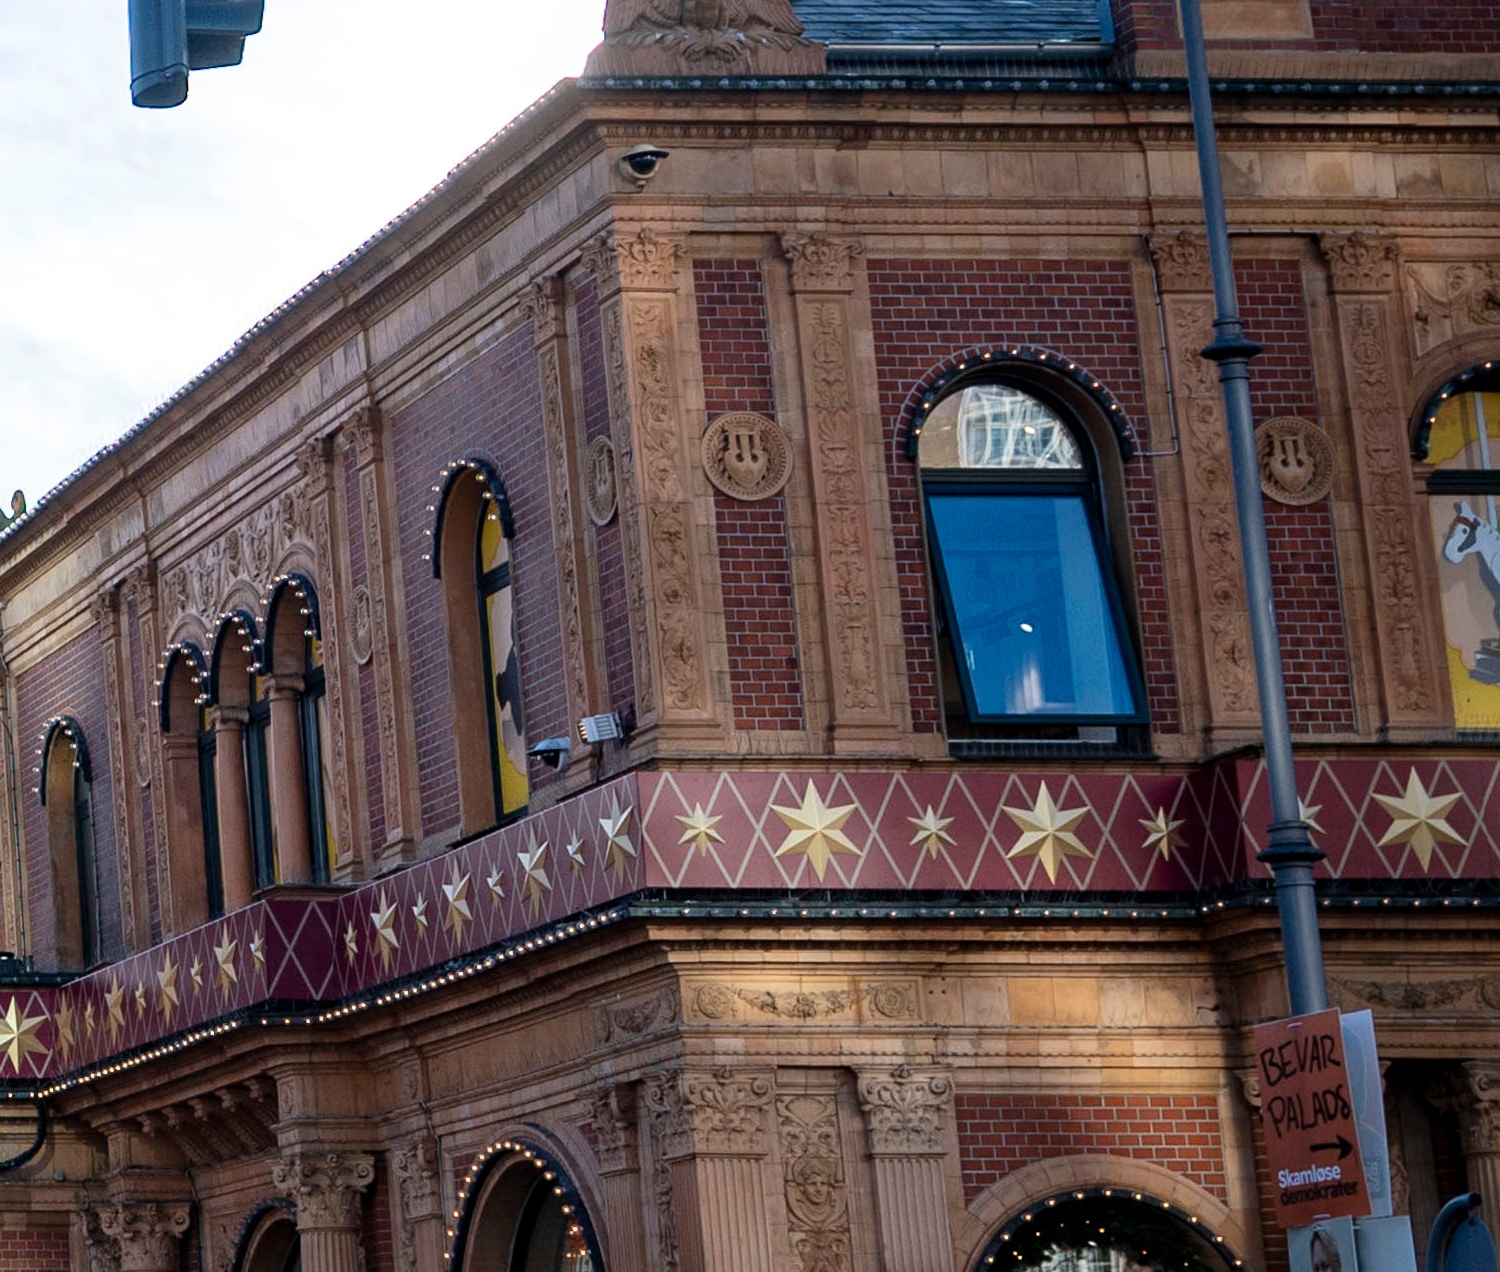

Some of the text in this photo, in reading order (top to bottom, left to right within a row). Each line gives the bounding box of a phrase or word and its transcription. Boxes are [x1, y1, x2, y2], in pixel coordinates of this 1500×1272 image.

[1260, 1034, 1341, 1086] BEVAR
[1268, 1084, 1351, 1138] PALADS
[1278, 1164, 1341, 1188] Skamløse
[1280, 1181, 1358, 1206] demokrater
